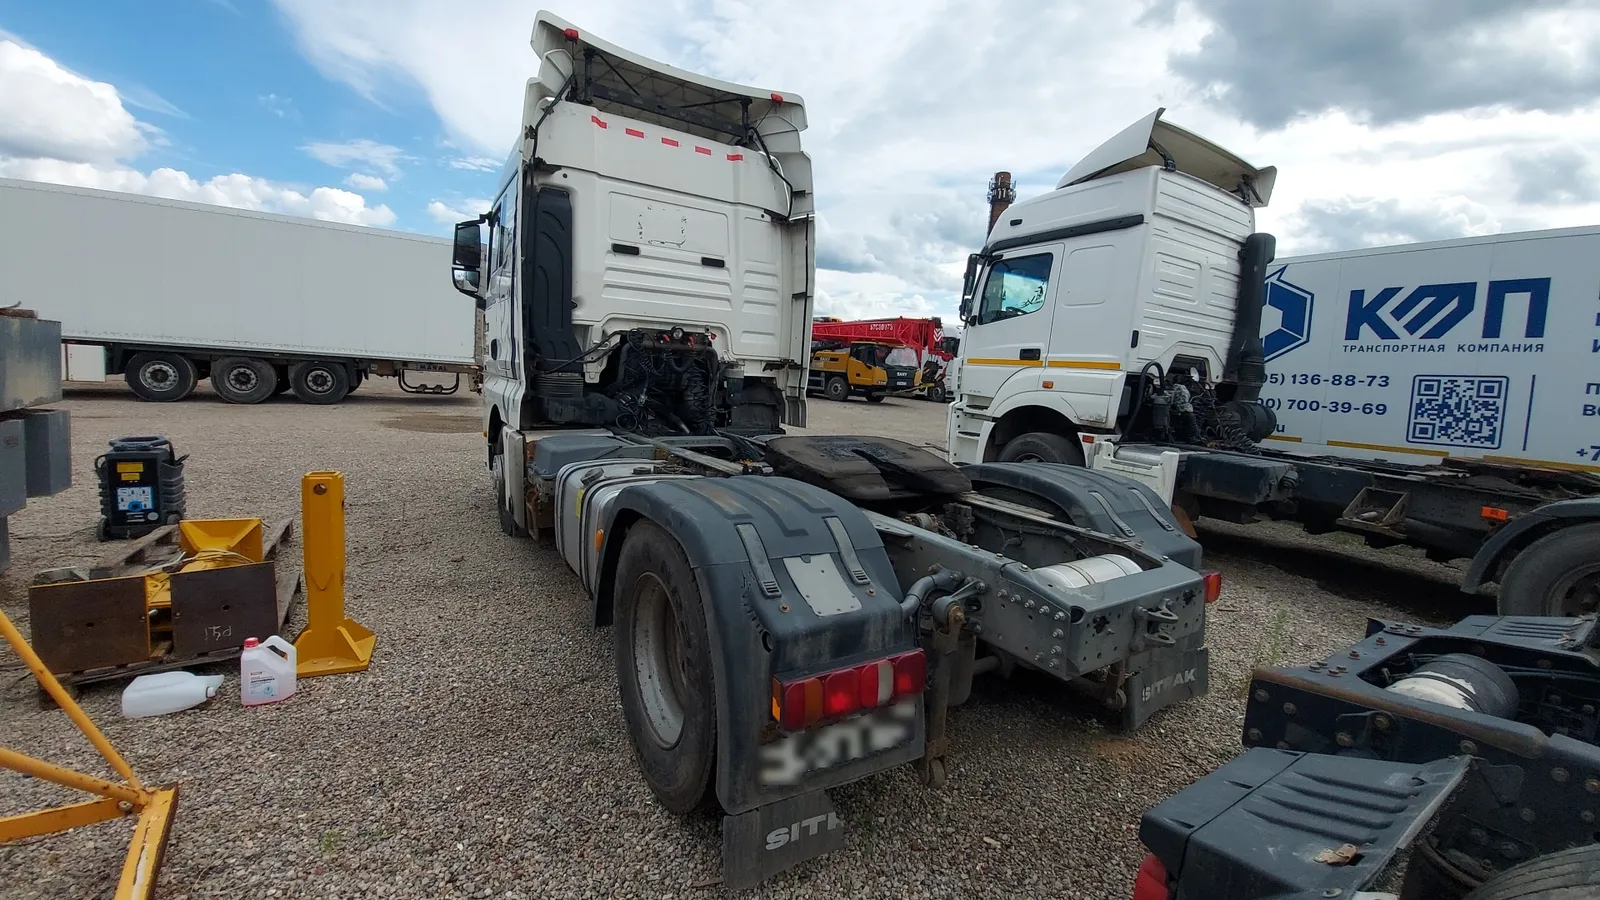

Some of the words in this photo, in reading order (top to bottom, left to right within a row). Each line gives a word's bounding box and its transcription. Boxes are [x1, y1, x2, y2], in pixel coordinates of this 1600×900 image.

[1342, 344, 1446, 353] ТРАНСПОРТНАЯ
[1457, 343, 1544, 353] КОМПАНИЯ
[1291, 374, 1390, 387] 136-88-73
[1287, 399, 1387, 415] 700-39-69
